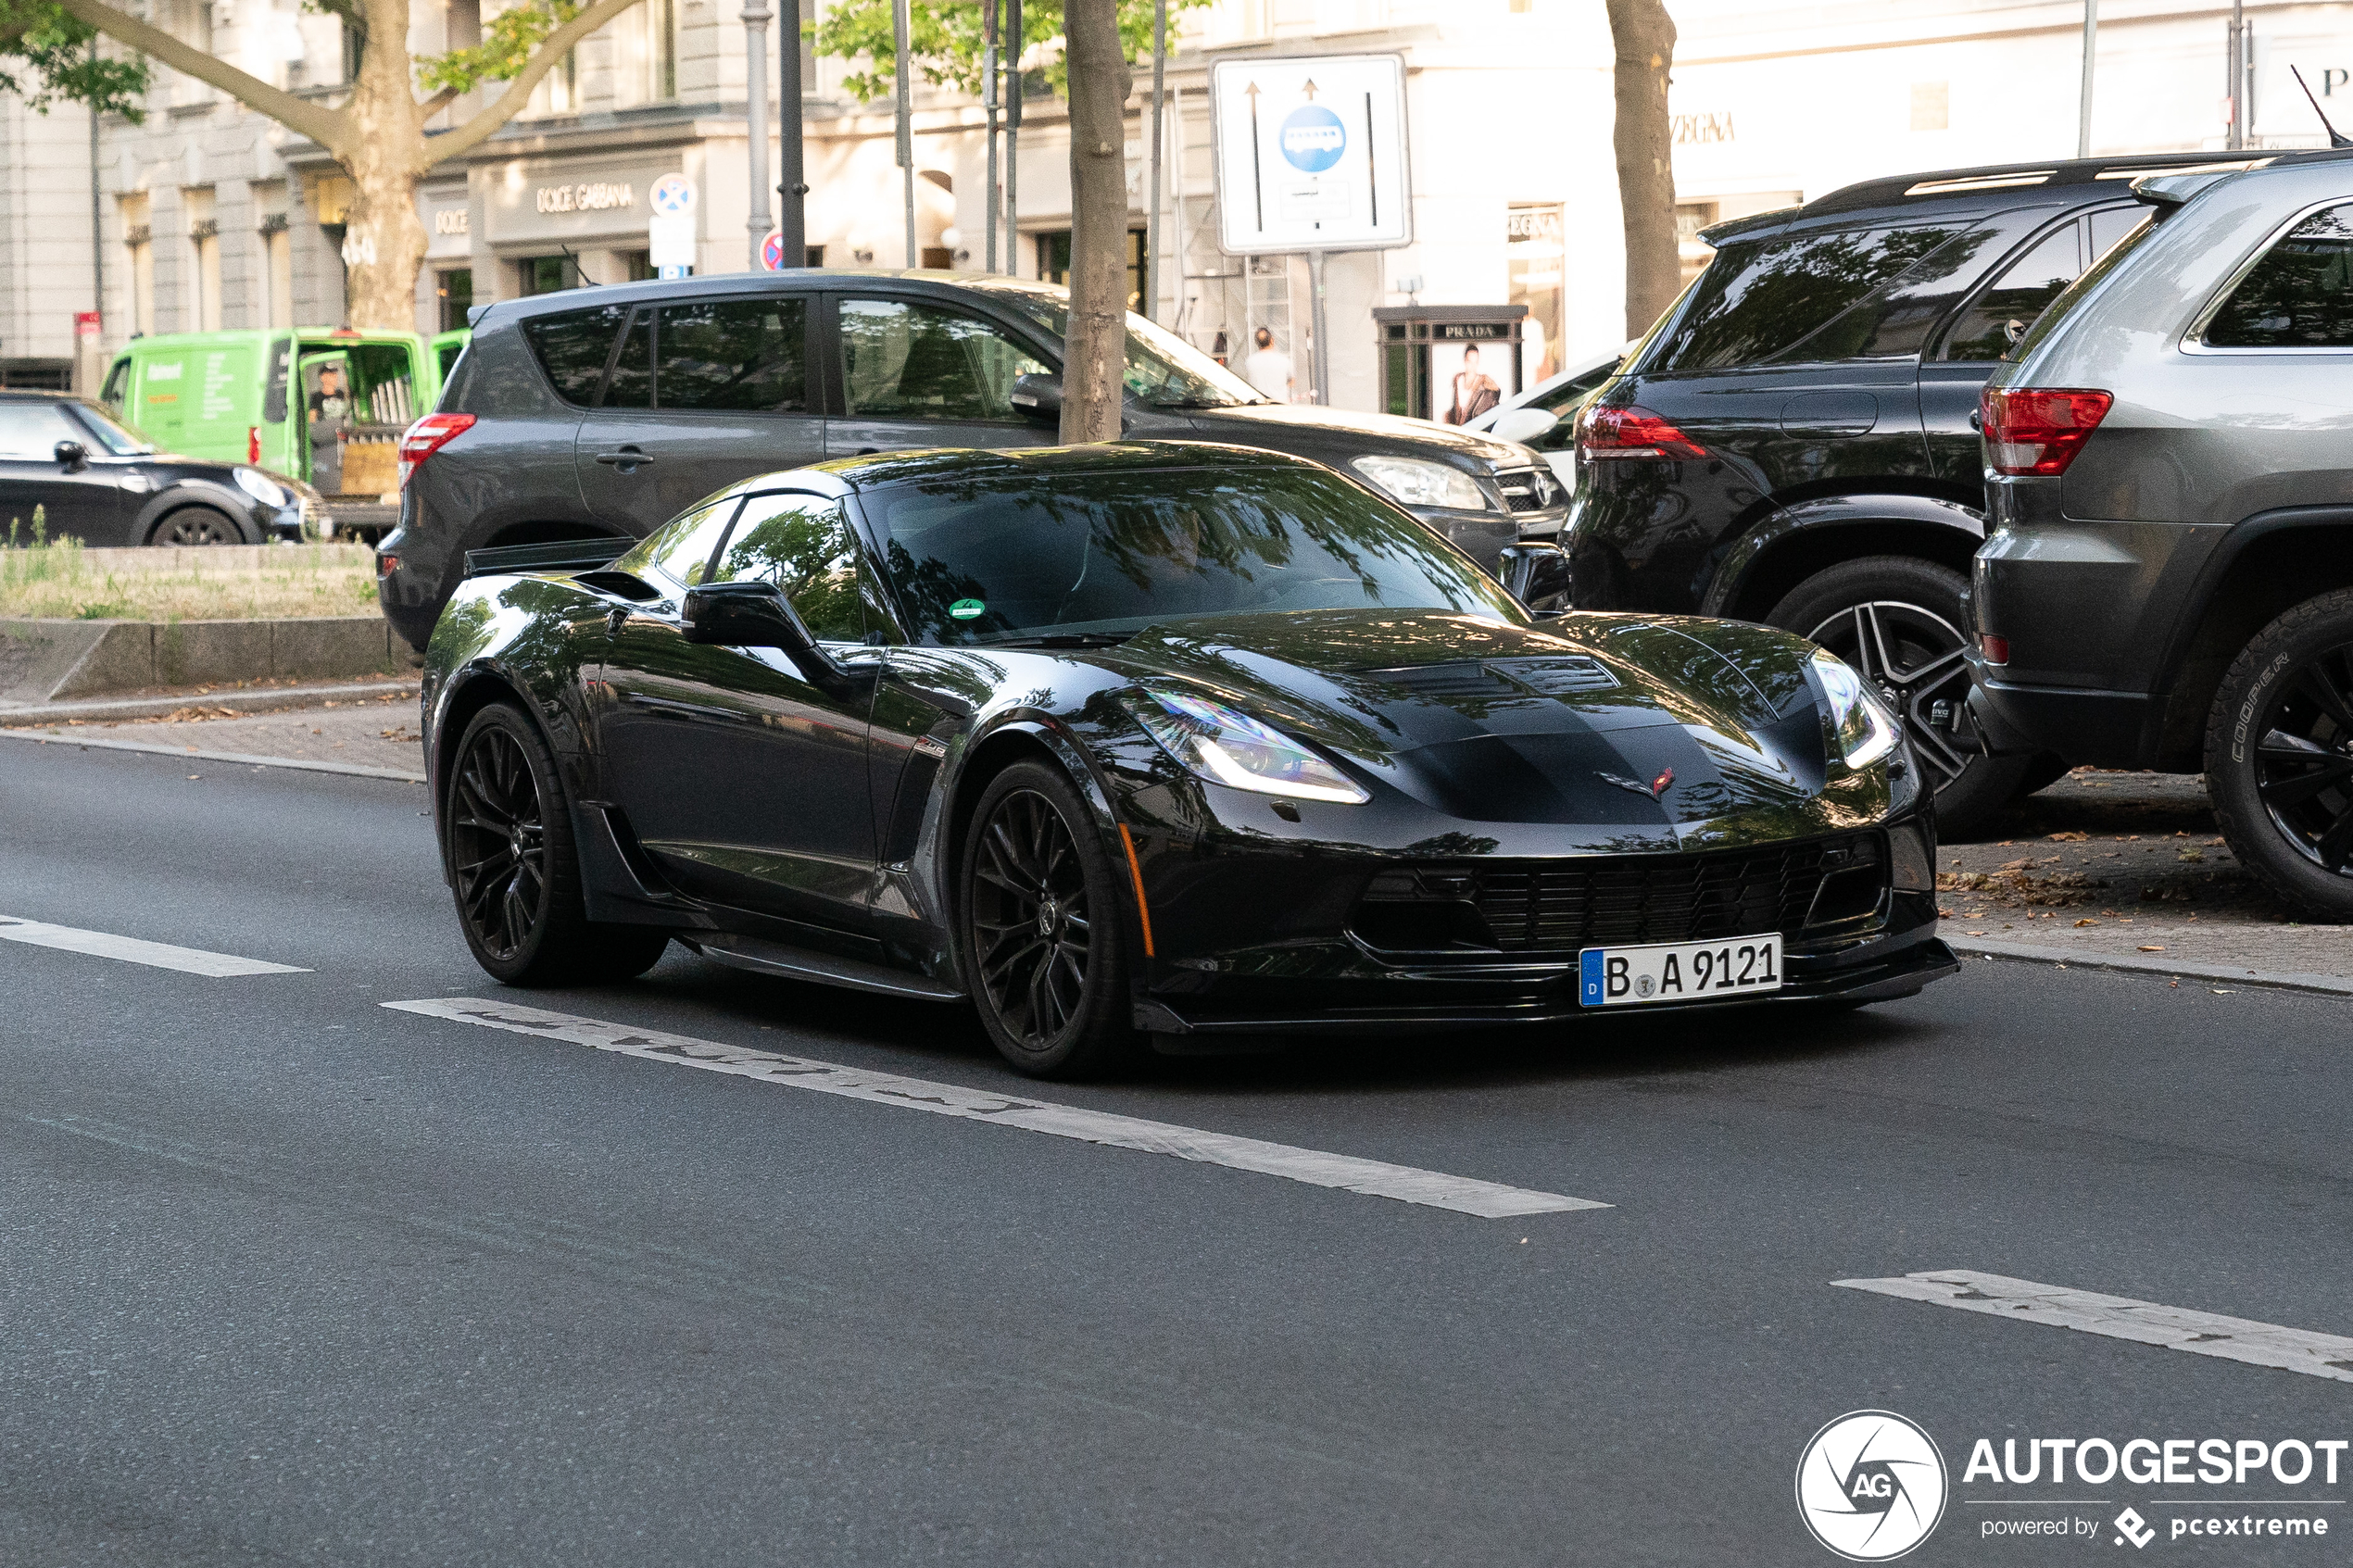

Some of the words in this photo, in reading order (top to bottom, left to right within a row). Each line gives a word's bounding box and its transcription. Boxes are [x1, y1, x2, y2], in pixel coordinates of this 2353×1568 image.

[1669, 111, 1736, 144] ZEGNA
[1508, 214, 1560, 235] EGNA
[1445, 325, 1495, 339] PRADA
[2232, 652, 2290, 763] COOPER
[1606, 956, 1630, 997] B
[1660, 953, 1683, 994] A
[1692, 943, 1778, 991] 9121
[1588, 983, 1597, 995] D
